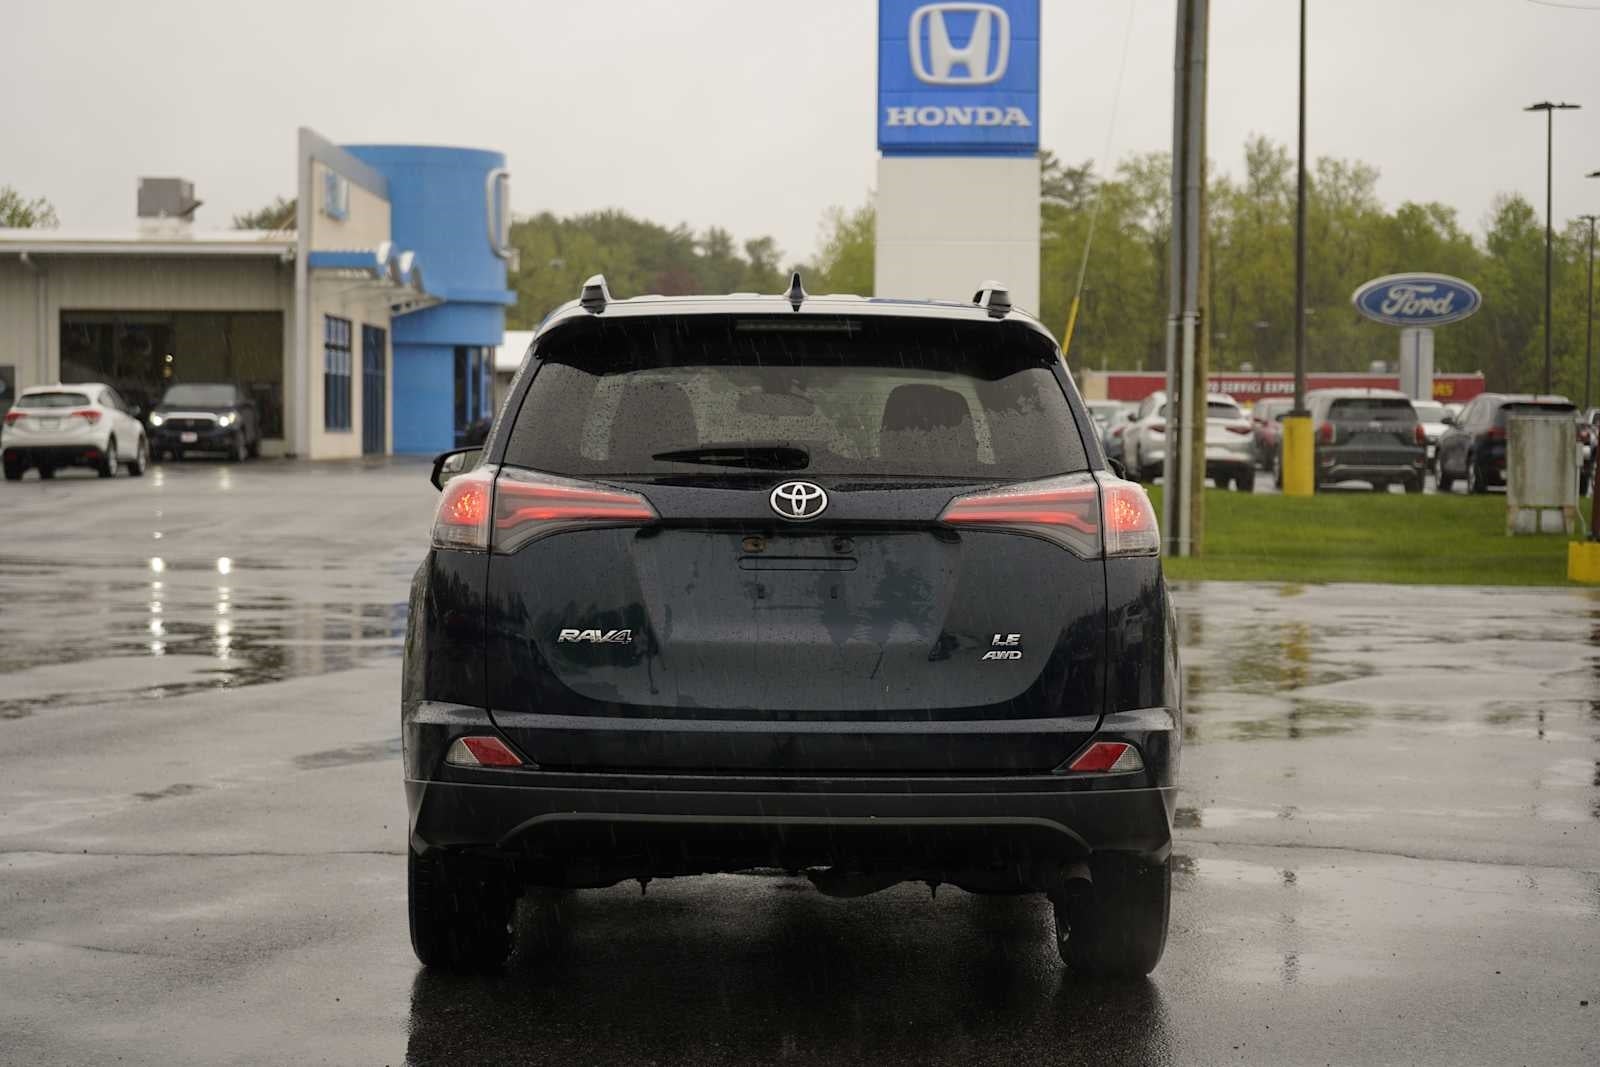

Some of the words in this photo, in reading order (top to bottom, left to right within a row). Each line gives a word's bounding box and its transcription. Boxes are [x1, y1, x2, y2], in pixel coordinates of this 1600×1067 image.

[886, 106, 1032, 127] HONDA
[1381, 284, 1455, 315] Ford
[557, 628, 633, 645] RAV4
[992, 633, 1021, 646] LE
[982, 650, 1022, 660] AWD
